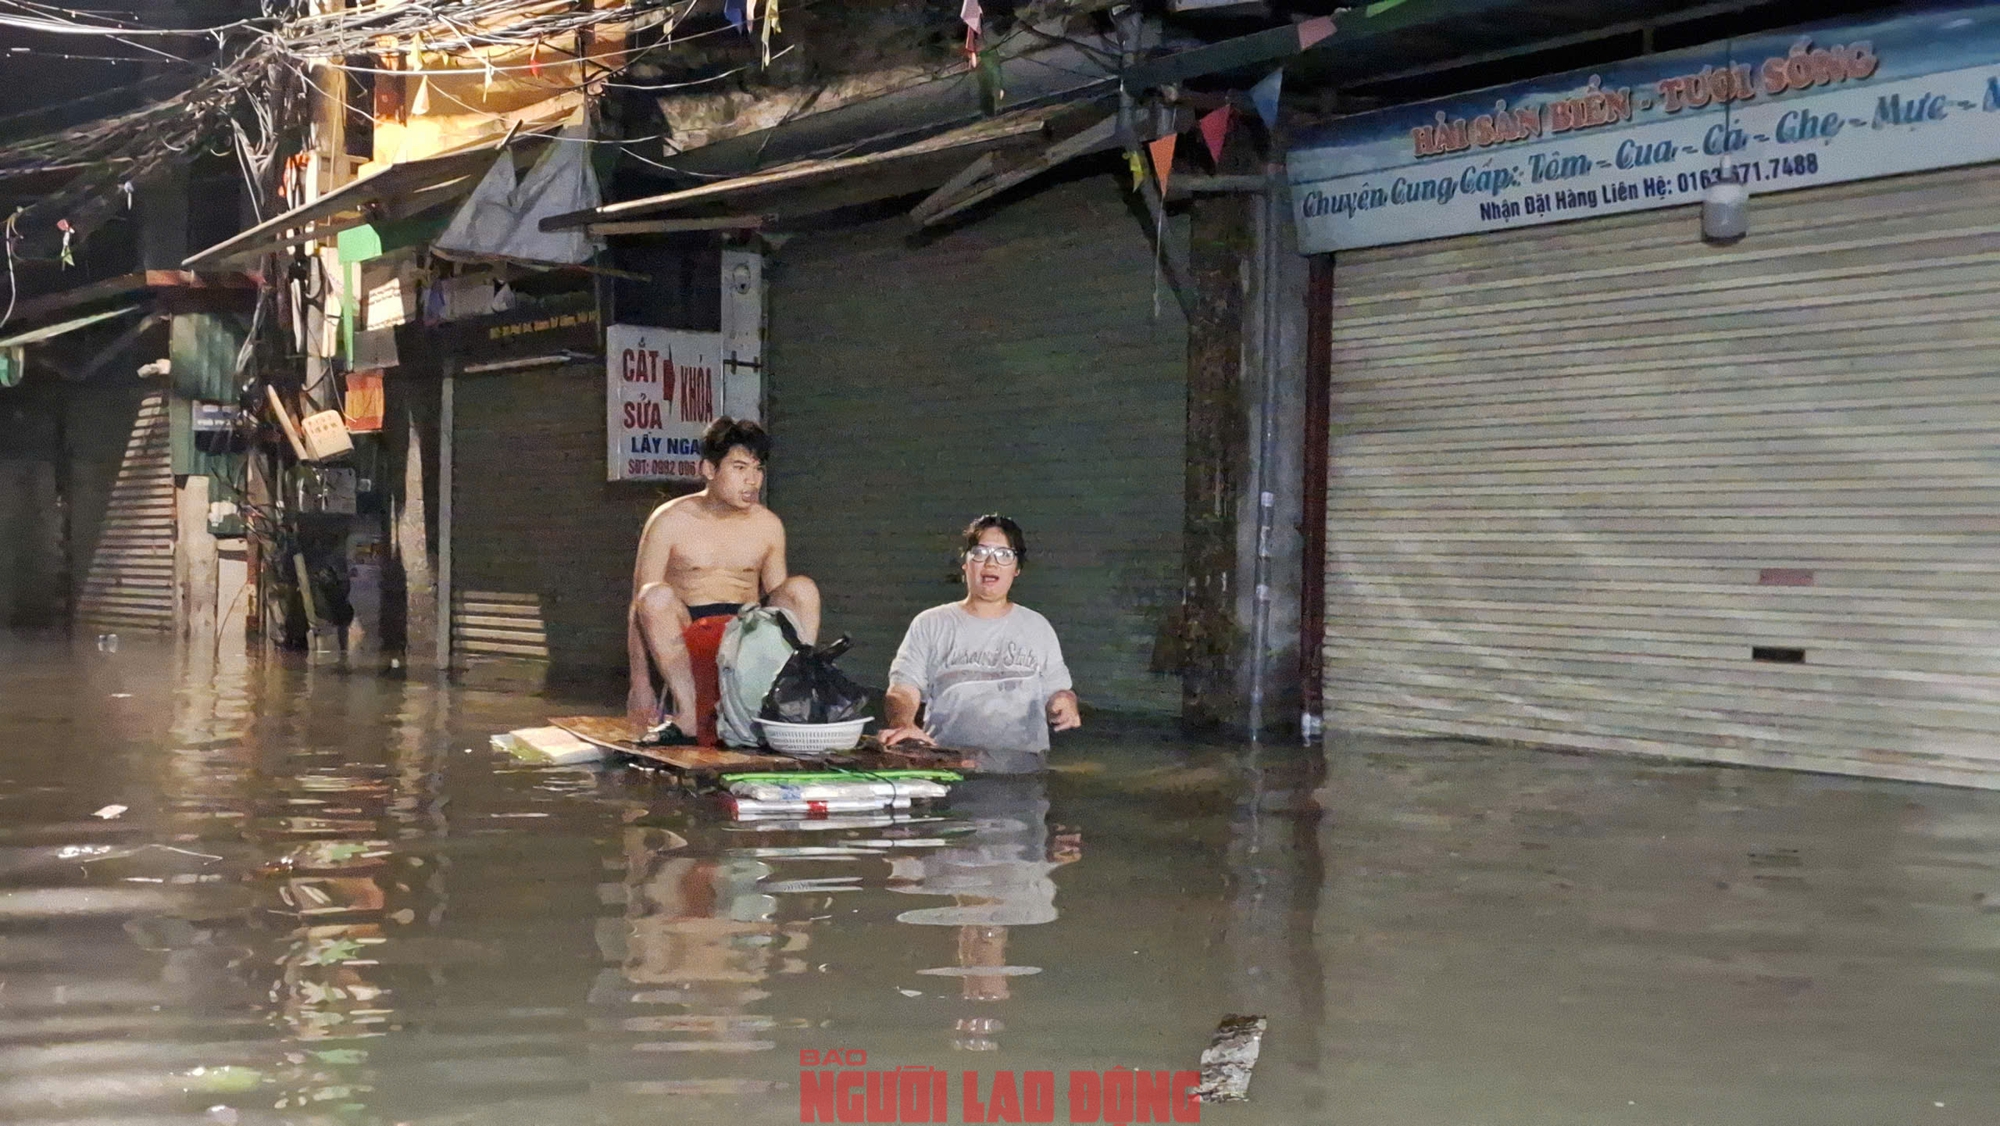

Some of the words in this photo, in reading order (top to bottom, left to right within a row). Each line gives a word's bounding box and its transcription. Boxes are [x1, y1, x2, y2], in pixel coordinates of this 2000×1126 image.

[1411, 110, 1470, 157] HẢI
[1474, 99, 1542, 146] SẢN
[1551, 74, 1631, 134] BIỂN
[1658, 61, 1754, 113] TƯƠI
[1761, 35, 1879, 95] SỐNG
[1303, 182, 1387, 218] Chuyên
[1390, 176, 1458, 205] Cung
[1529, 151, 1590, 184] Tôm
[1615, 139, 1676, 170] Cua
[1703, 119, 1748, 155] Cá
[1776, 109, 1844, 146] Ghẹ
[1480, 200, 1520, 223] Nhận
[1525, 197, 1552, 218] Đặt
[1556, 188, 1598, 210] Hàng
[1602, 182, 1639, 205] Liên
[1643, 175, 1672, 200] Hệ:
[623, 336, 659, 383] CẮT
[624, 393, 662, 430] SỬA
[681, 354, 713, 423] KHÓA
[631, 432, 661, 454] LẤY
[667, 438, 701, 455] NGA
